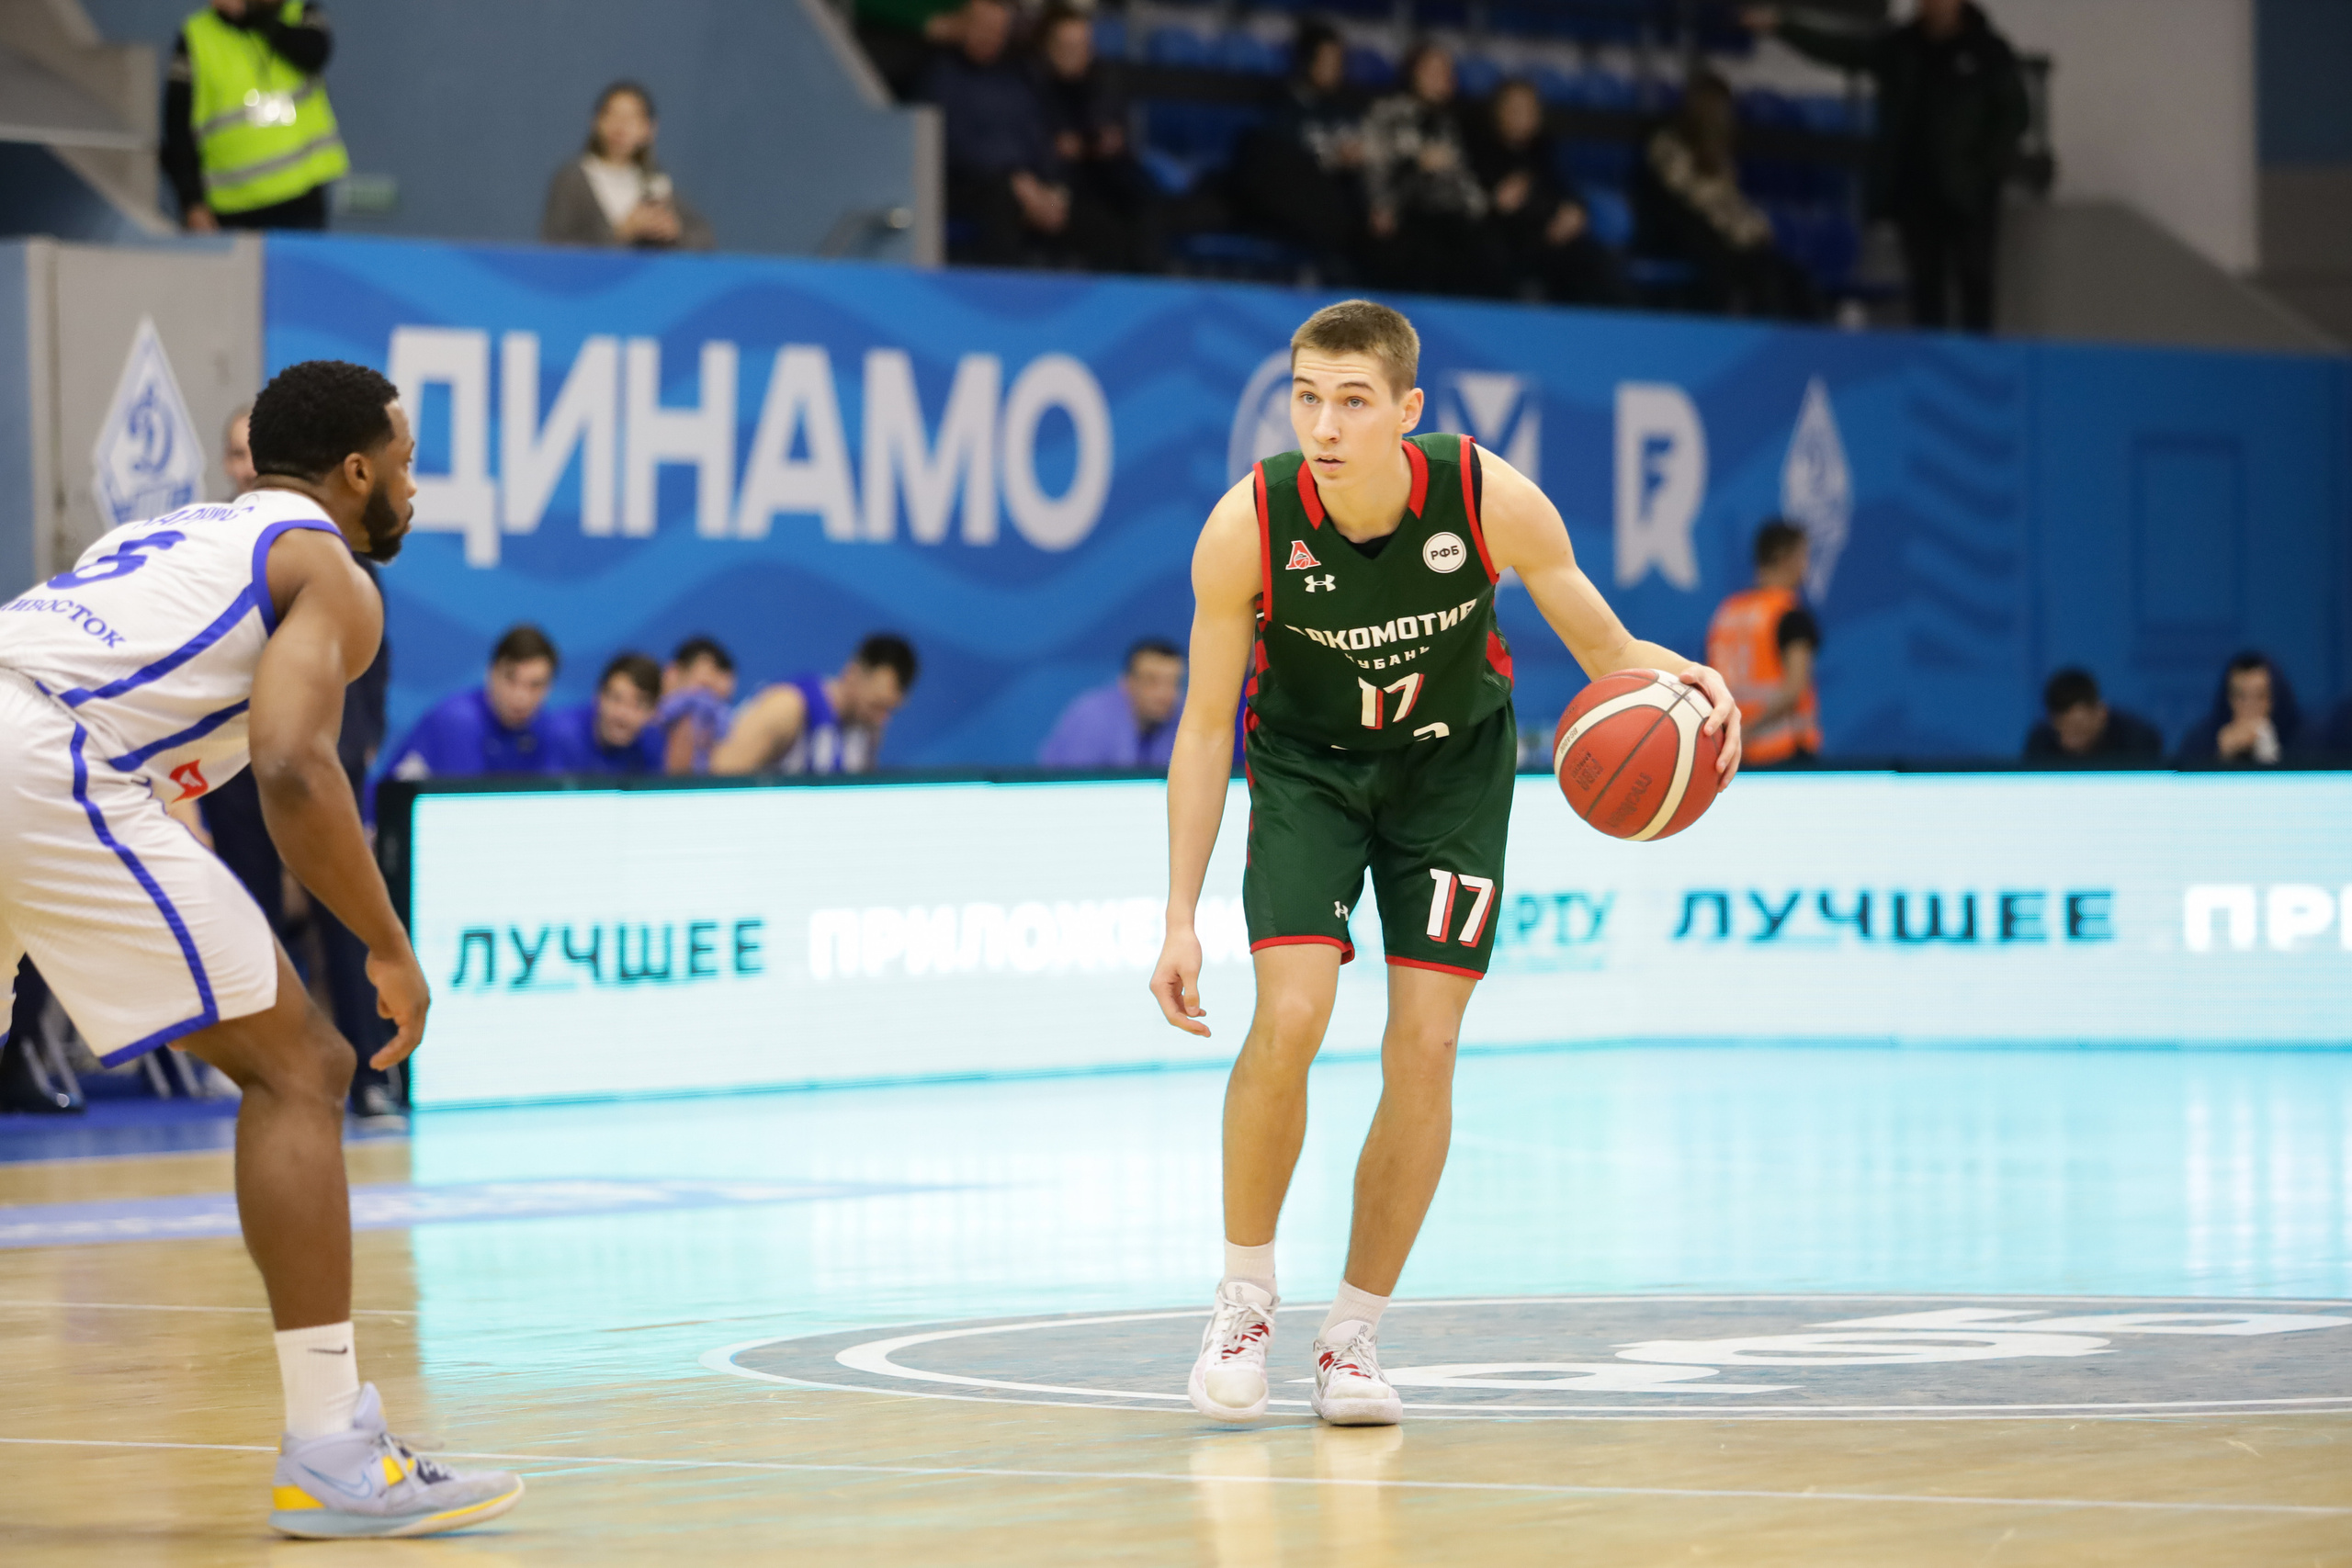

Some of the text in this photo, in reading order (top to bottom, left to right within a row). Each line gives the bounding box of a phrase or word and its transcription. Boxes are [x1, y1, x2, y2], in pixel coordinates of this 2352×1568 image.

[387, 324, 1114, 569] ДИНАМО
[1430, 545, 1460, 560] РФБ
[0, 599, 126, 649] ИВОСТОК
[1284, 598, 1477, 650] ОКОМОТИВ
[1358, 672, 1424, 729] 17
[450, 917, 765, 990] ЛУЧШЕЕ
[1670, 887, 2116, 946] ЛУЧШЕЕ
[2183, 883, 2352, 953] ПР
[1426, 868, 1496, 948] 17
